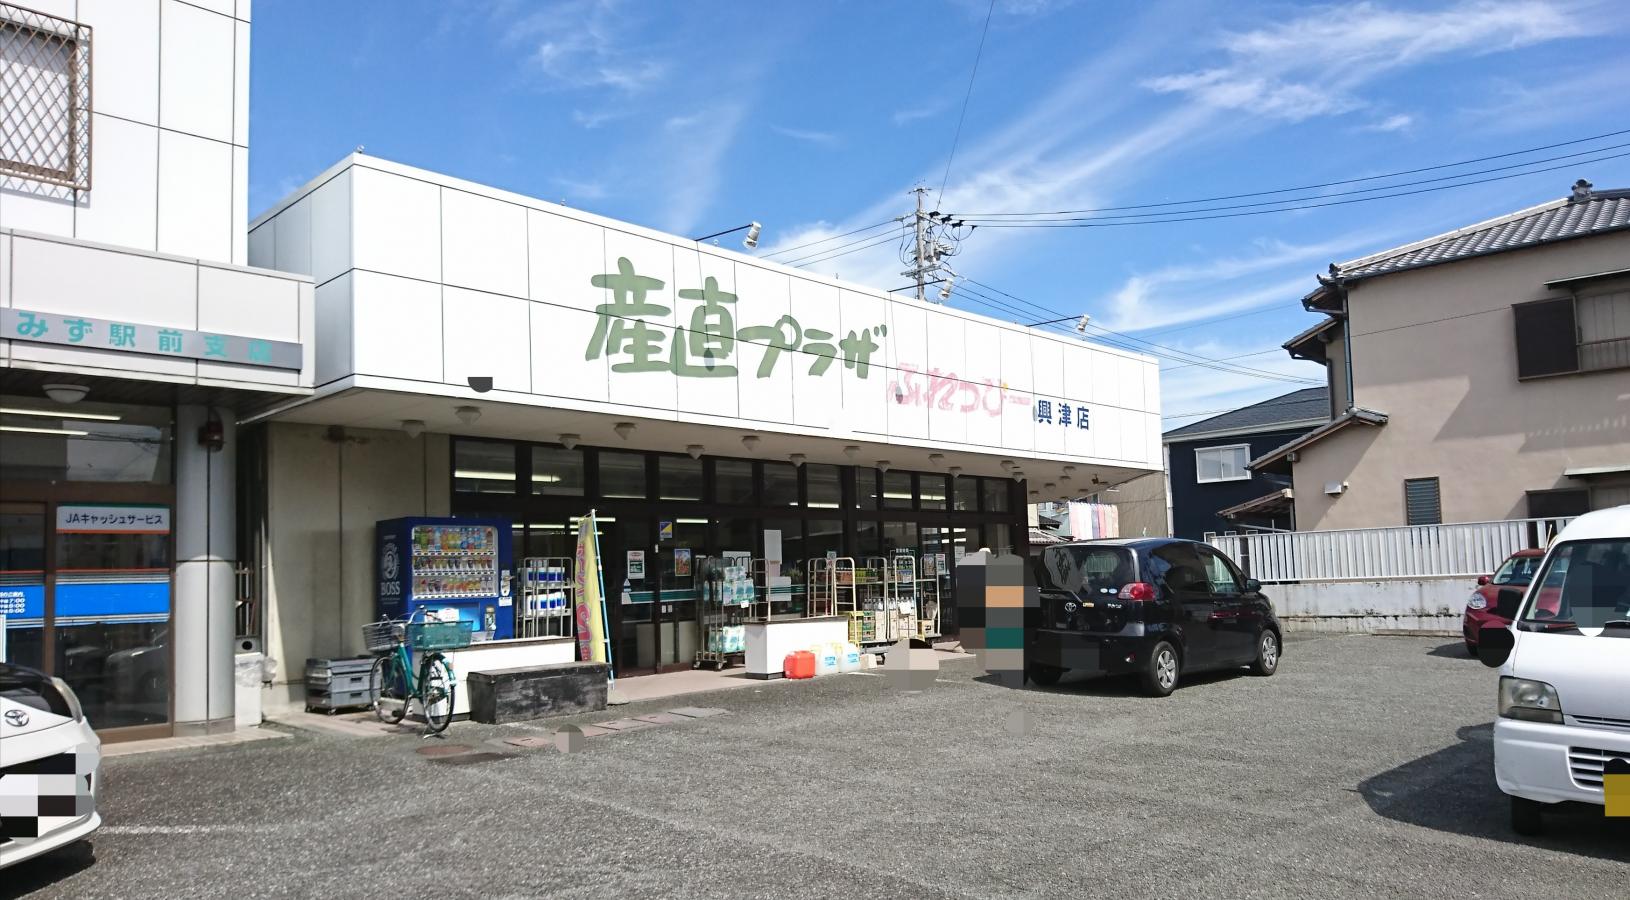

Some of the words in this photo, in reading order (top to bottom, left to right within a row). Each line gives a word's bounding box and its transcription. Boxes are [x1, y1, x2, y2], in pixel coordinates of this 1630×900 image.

[16, 311, 273, 363] みず駅前支店
[585, 257, 887, 378] 産直プラザ
[1037, 399, 1090, 430] 興津店
[65, 513, 163, 525] JAキャッシュサービス
[381, 581, 401, 595] BOSS
